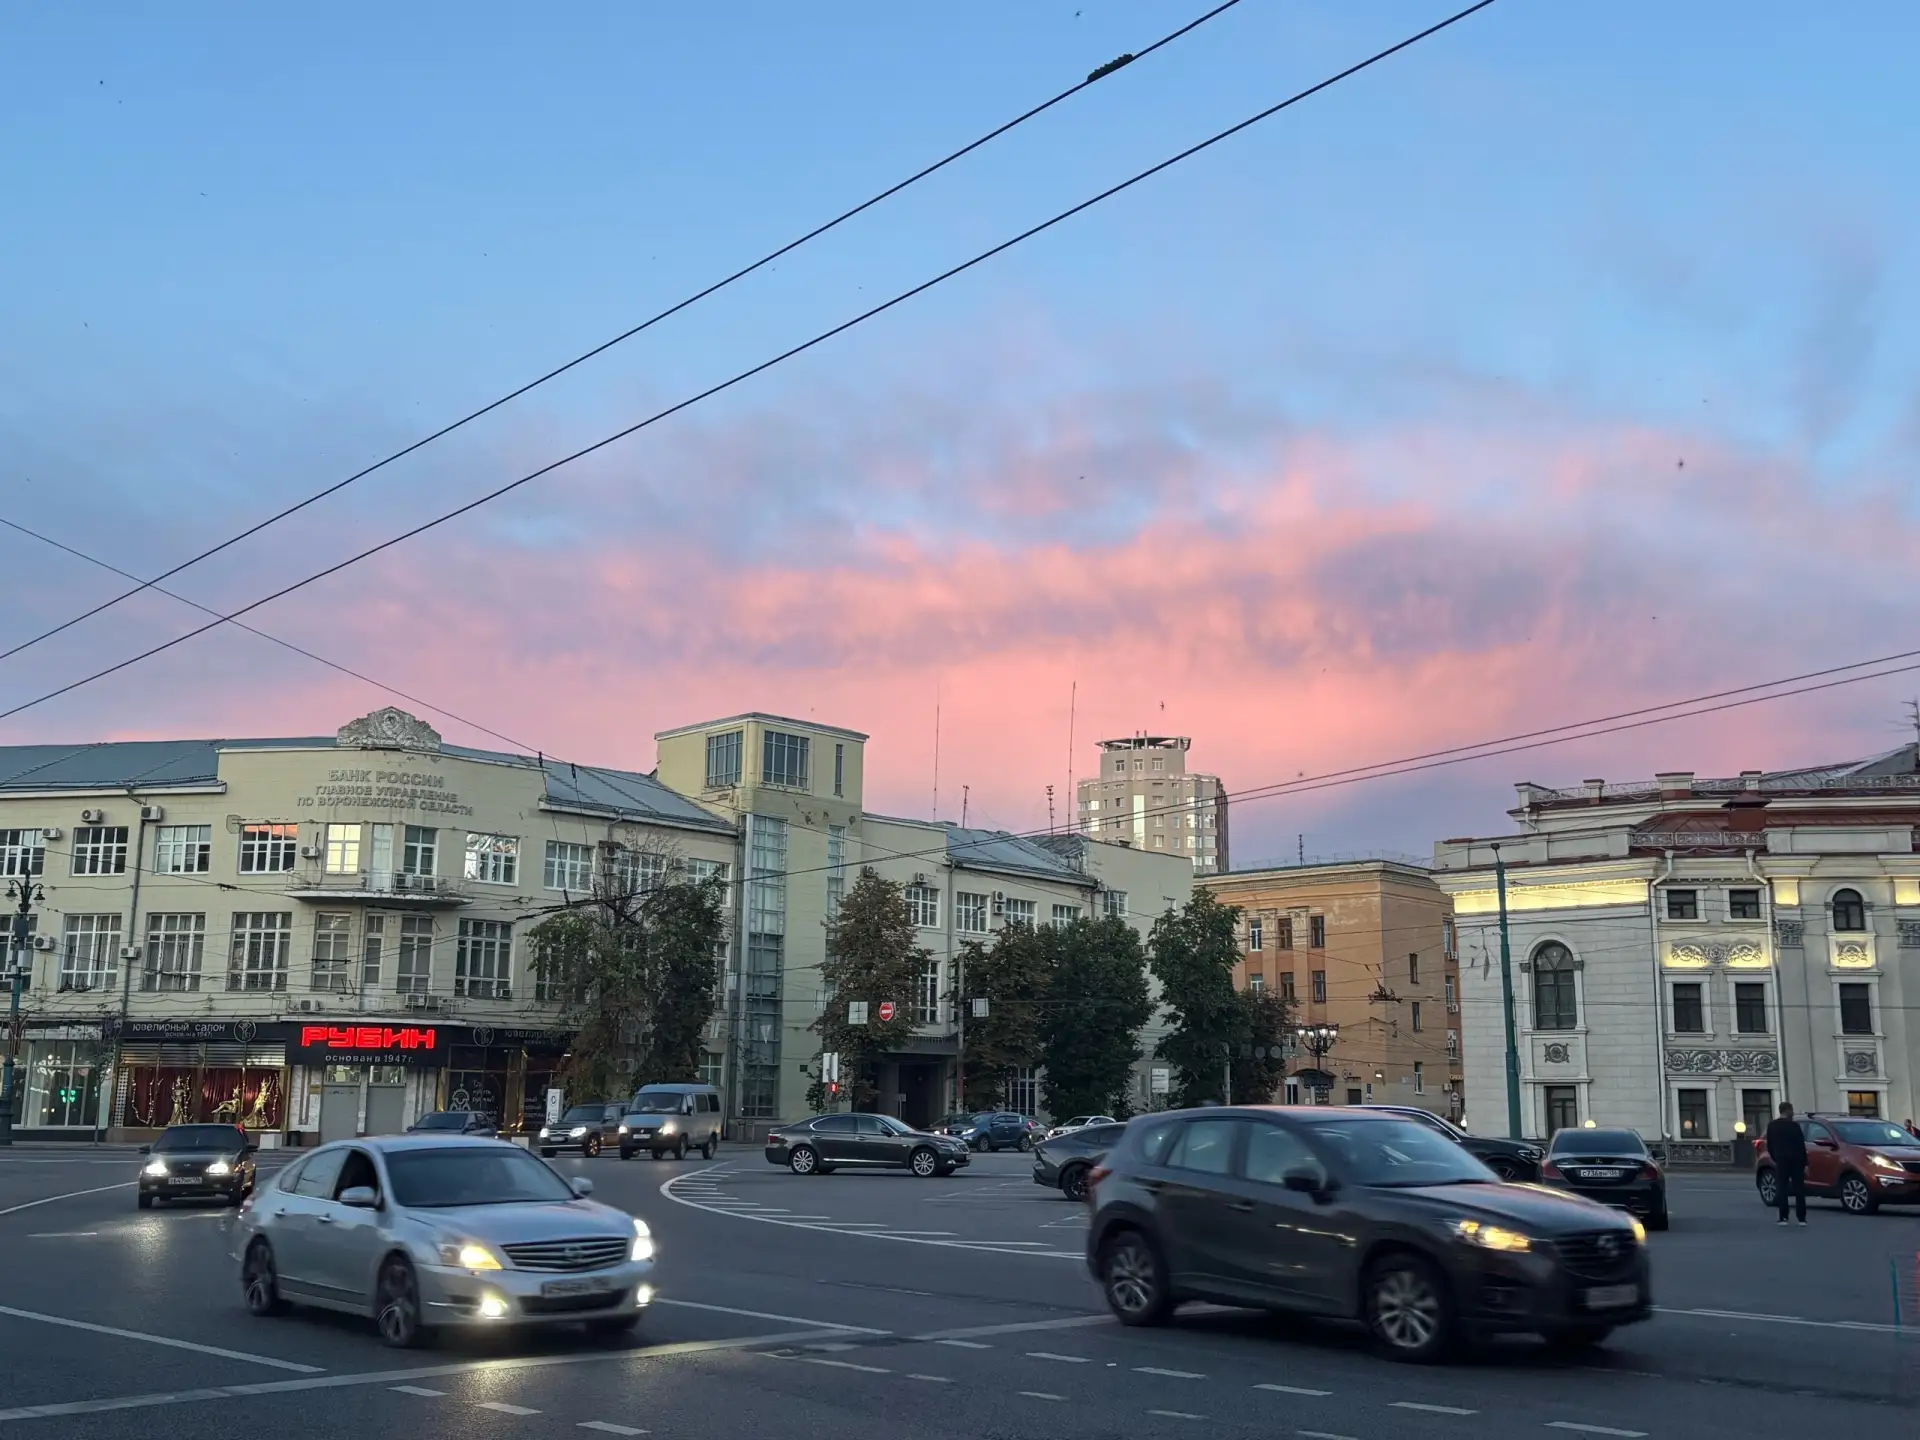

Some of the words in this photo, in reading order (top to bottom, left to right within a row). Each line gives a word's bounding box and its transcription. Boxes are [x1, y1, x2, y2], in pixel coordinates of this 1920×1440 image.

[329, 769, 372, 783] БАНК
[375, 770, 445, 788] РОССИИ
[315, 785, 373, 796] ГЛАВНОЕ
[376, 787, 458, 803] УПРАВЛЕНИЕ
[297, 797, 313, 807] ПО
[317, 796, 416, 810] ВОРОНЕЖСКОЙ
[419, 801, 474, 816] ОБЛАСТИ
[132, 1022, 189, 1034] ювелирный
[195, 1023, 226, 1032] салон
[301, 1026, 435, 1049] РУБИН
[325, 1054, 373, 1062] основан
